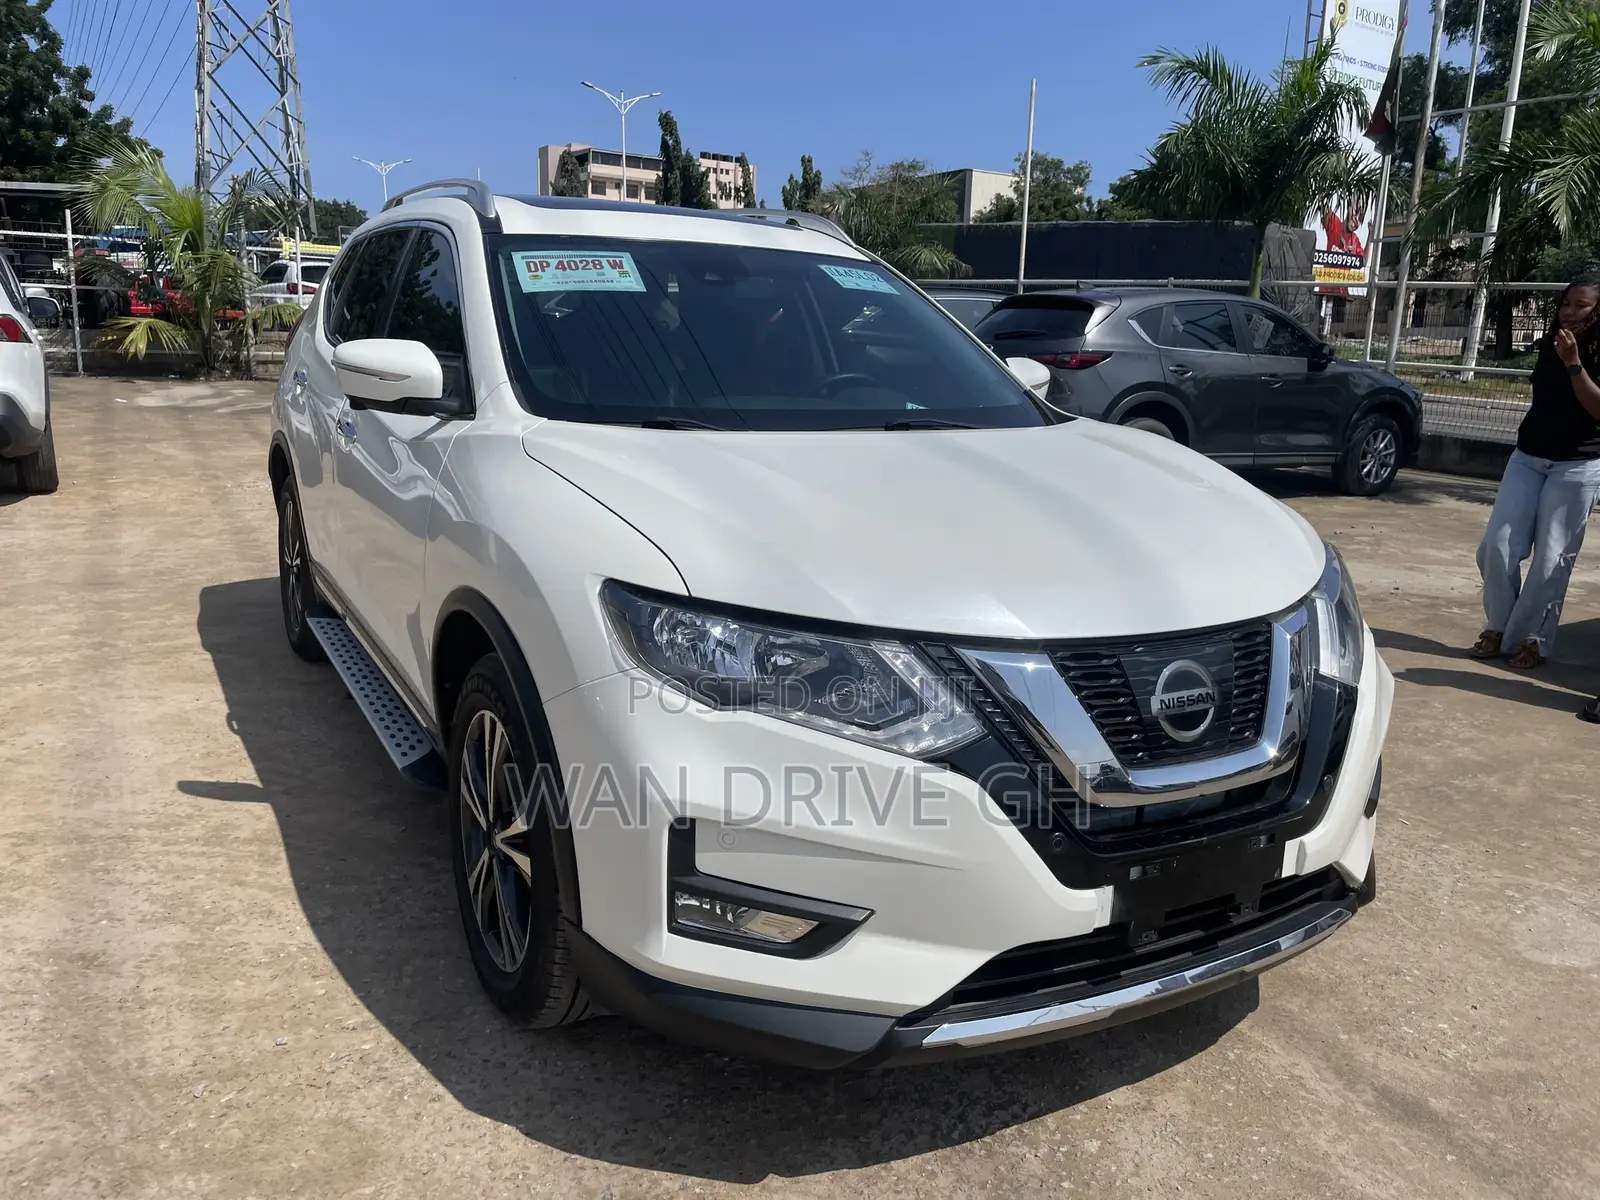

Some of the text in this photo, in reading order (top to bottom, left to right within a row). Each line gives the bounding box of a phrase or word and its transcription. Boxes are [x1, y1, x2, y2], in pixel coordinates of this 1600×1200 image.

[1355, 6, 1395, 31] PRODIGY
[1359, 75, 1382, 92] FUTUR
[525, 259, 625, 273] DP 4028 W
[1313, 252, 1360, 267] 0256097974
[1159, 690, 1216, 711] NISSAN
